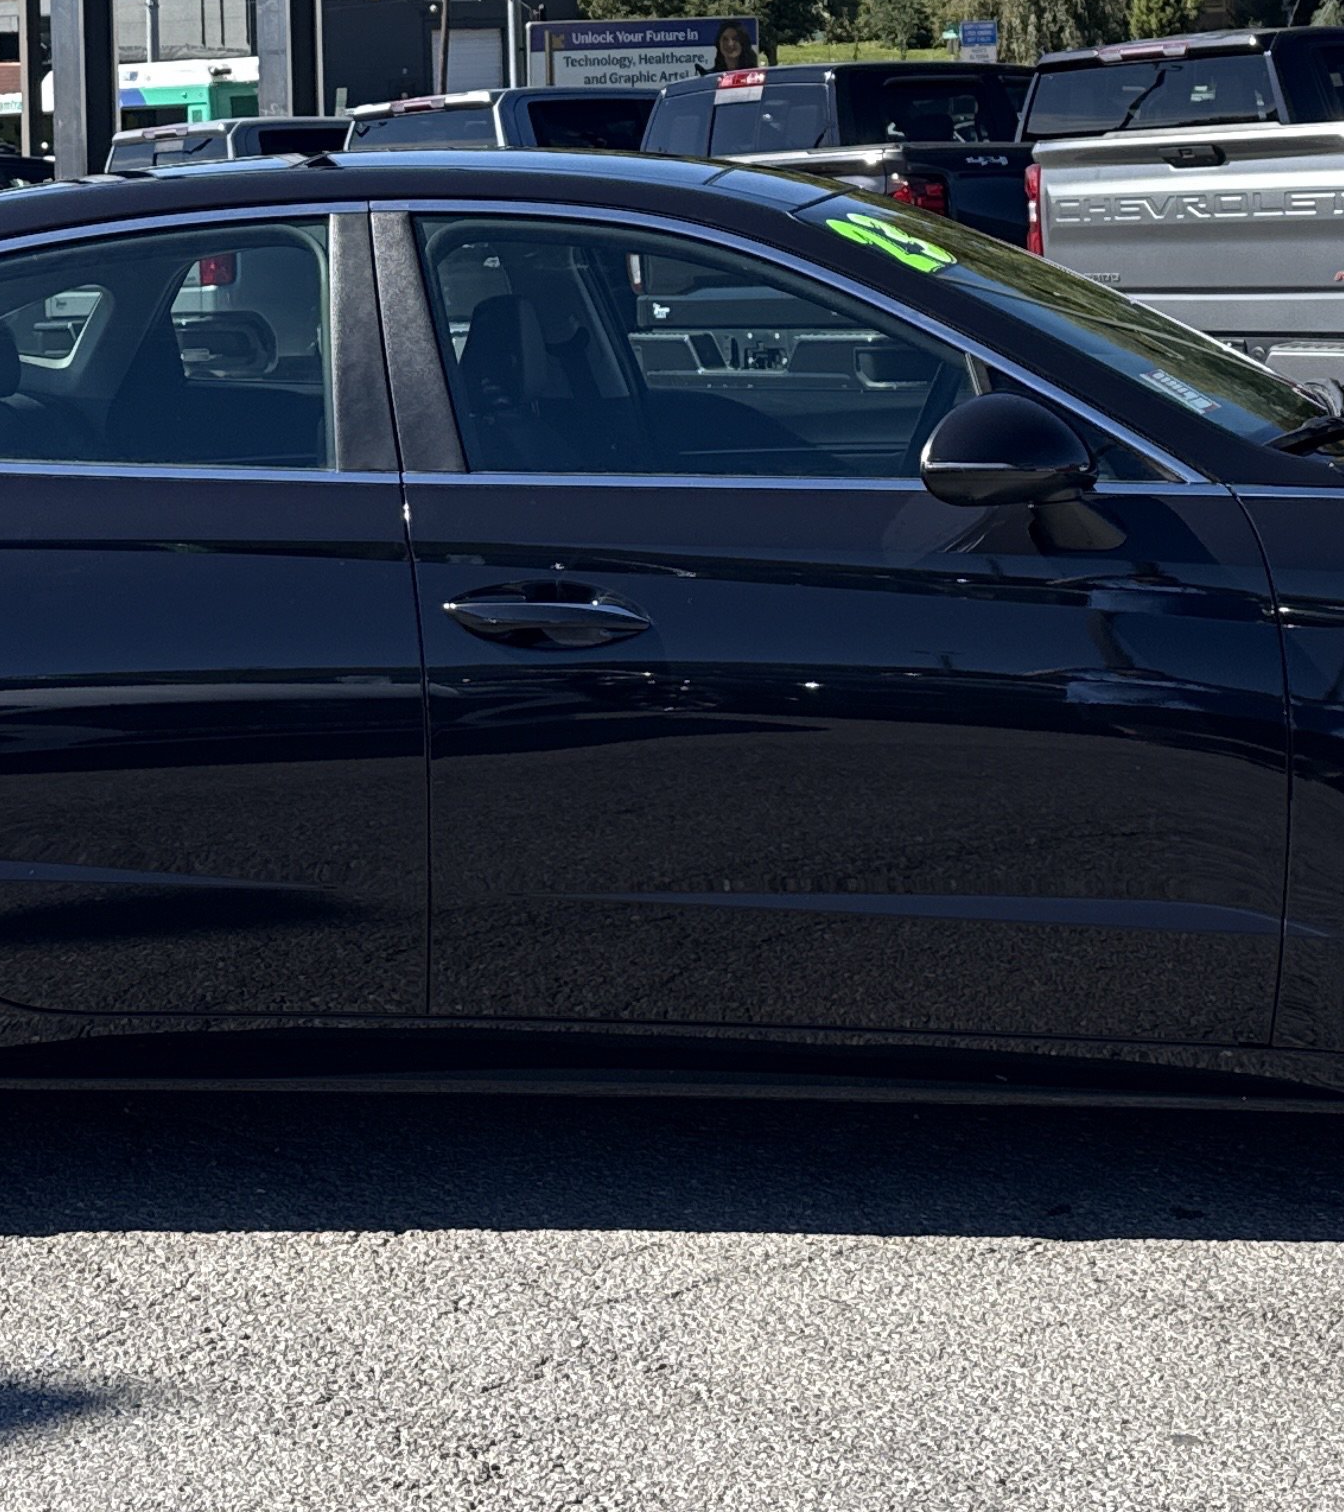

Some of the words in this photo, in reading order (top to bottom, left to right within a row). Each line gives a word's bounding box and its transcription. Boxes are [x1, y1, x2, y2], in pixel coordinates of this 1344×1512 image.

[571, 31, 614, 44] Unlock
[616, 31, 644, 43] Your
[646, 29, 685, 42] Future
[563, 54, 636, 68] Technology,
[638, 52, 709, 65] Healthcare,
[584, 72, 607, 84] and
[609, 70, 657, 88] Graphic
